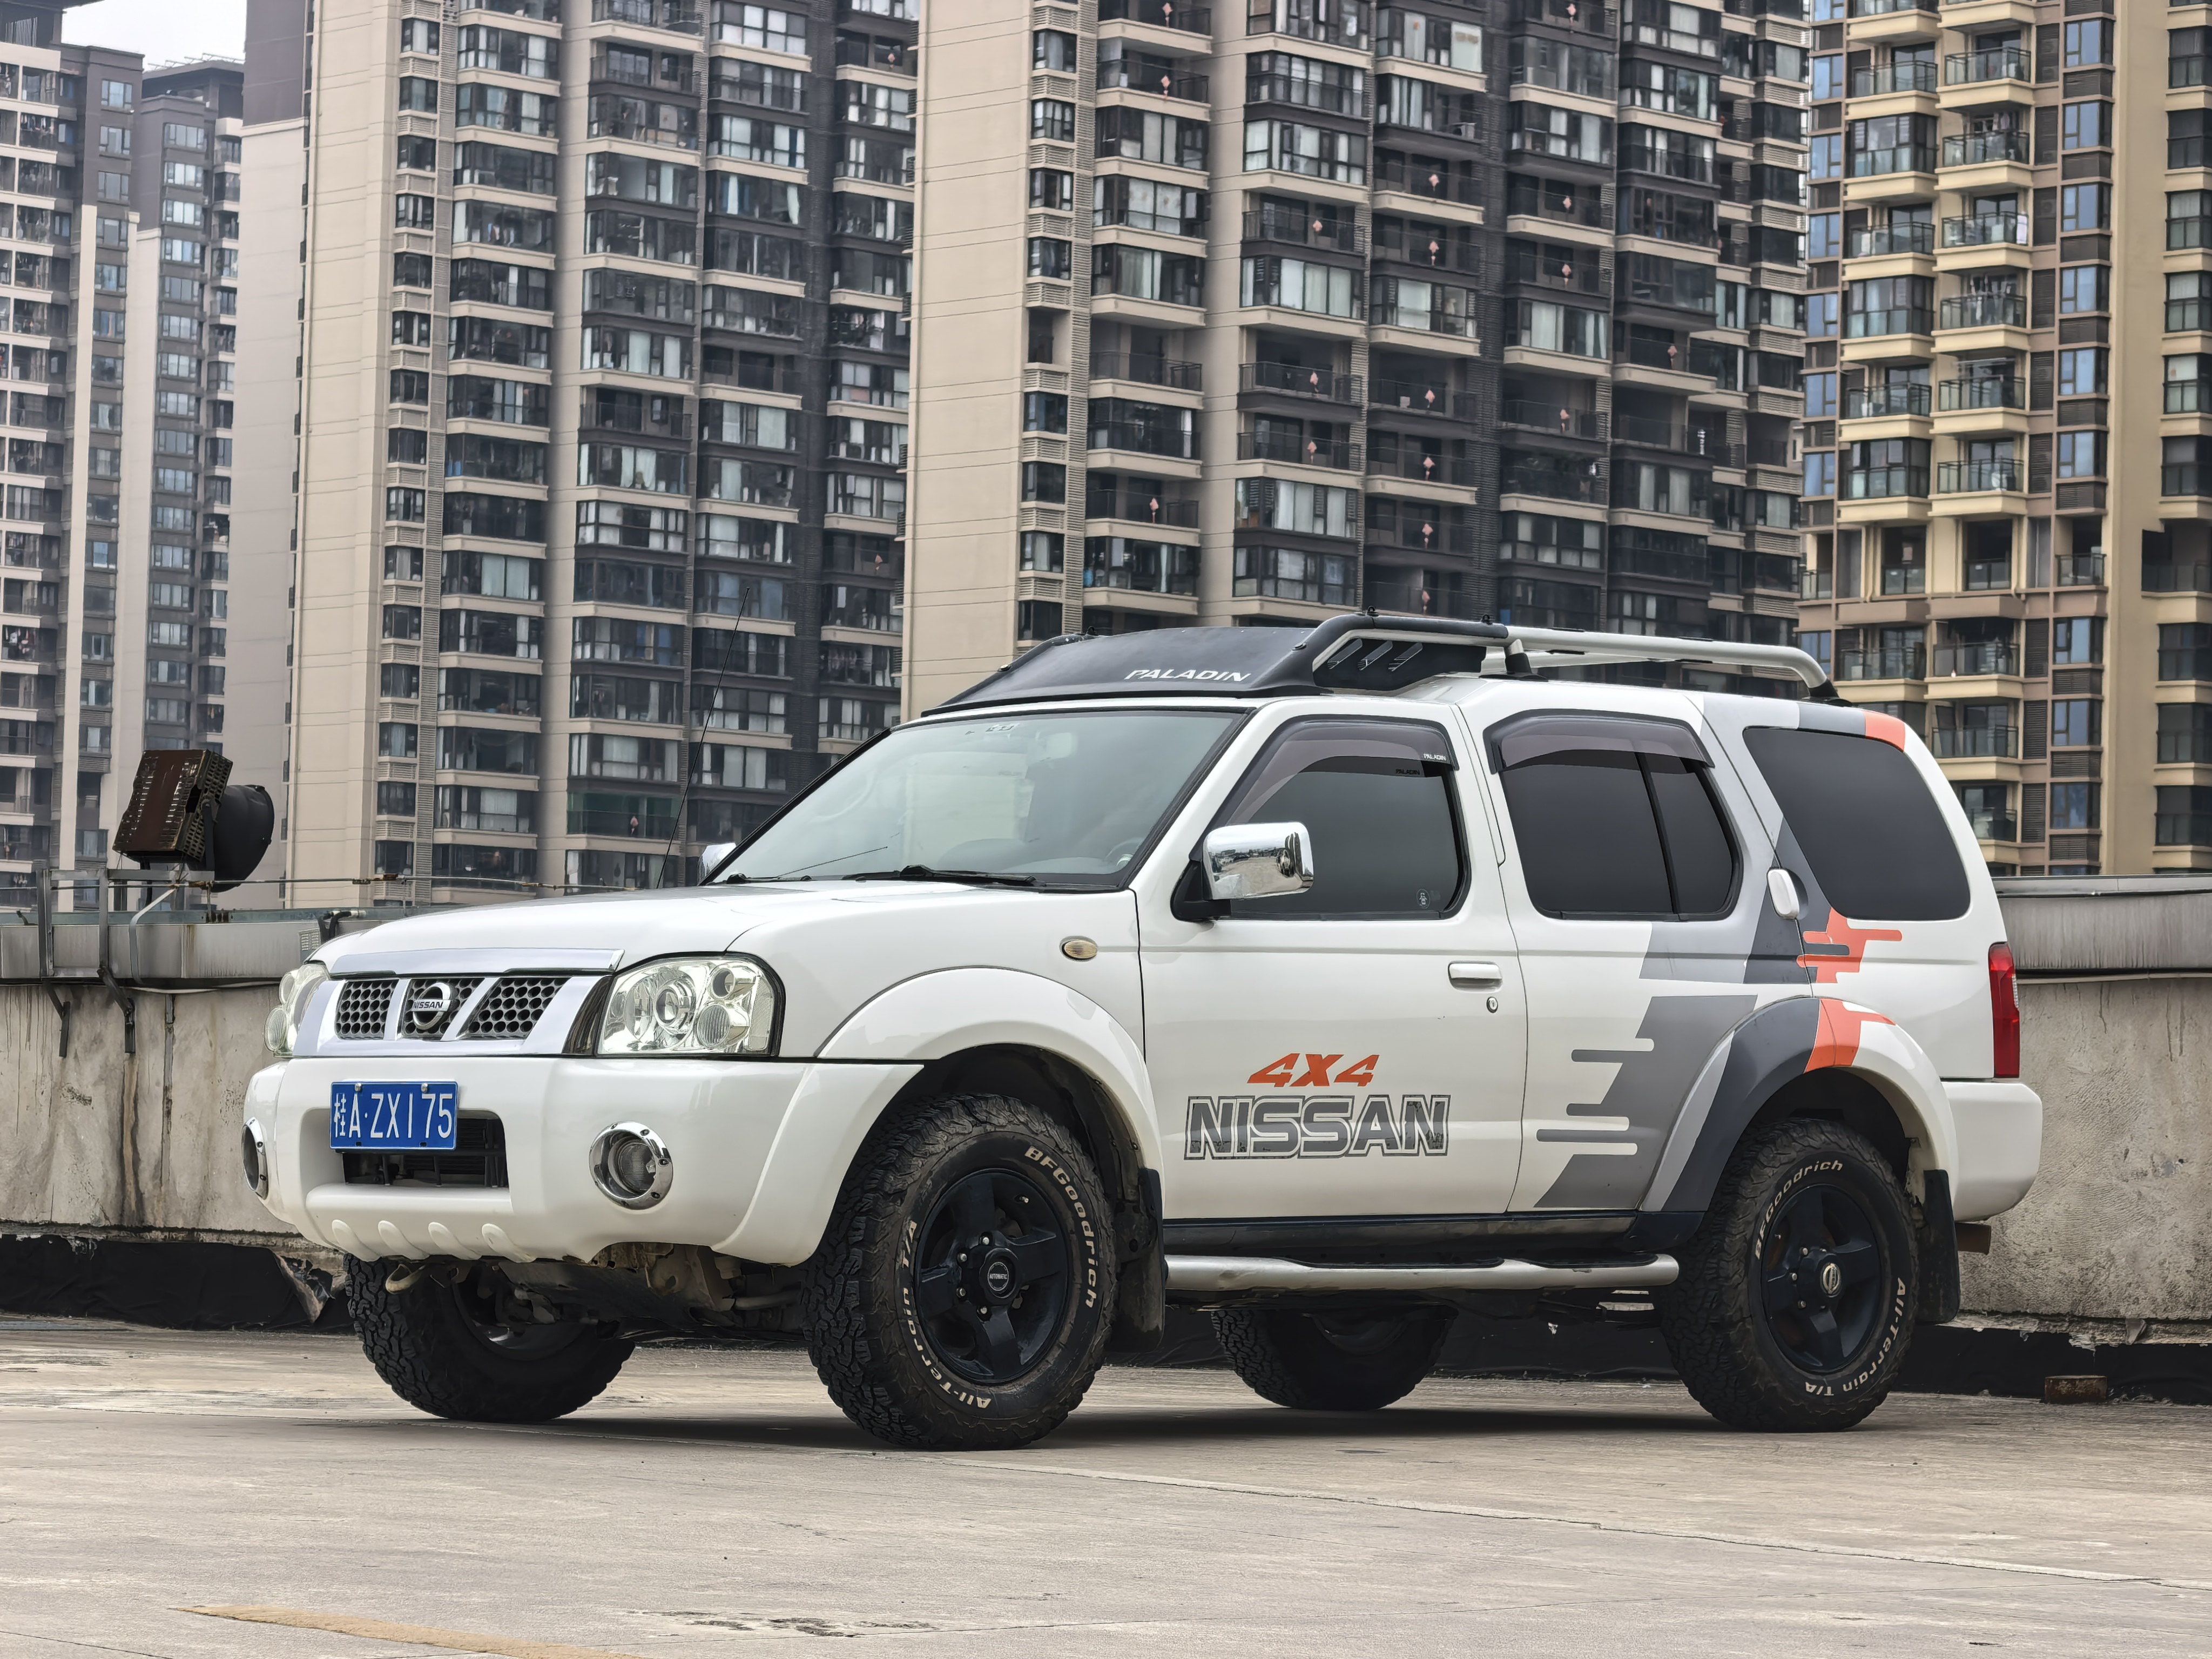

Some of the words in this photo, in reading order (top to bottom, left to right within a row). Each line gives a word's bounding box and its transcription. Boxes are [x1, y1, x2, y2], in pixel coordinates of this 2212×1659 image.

[1124, 669, 1251, 682] PALADIN
[1247, 1053, 1380, 1087] 4X4
[1184, 1095, 1451, 1161] NISSAN
[1025, 1146, 1097, 1308] BFGoodrich
[1755, 1160, 1843, 1259] BFGoodrich
[1843, 1277, 1906, 1392] All-Terrain
[1805, 1381, 1835, 1397] T/A
